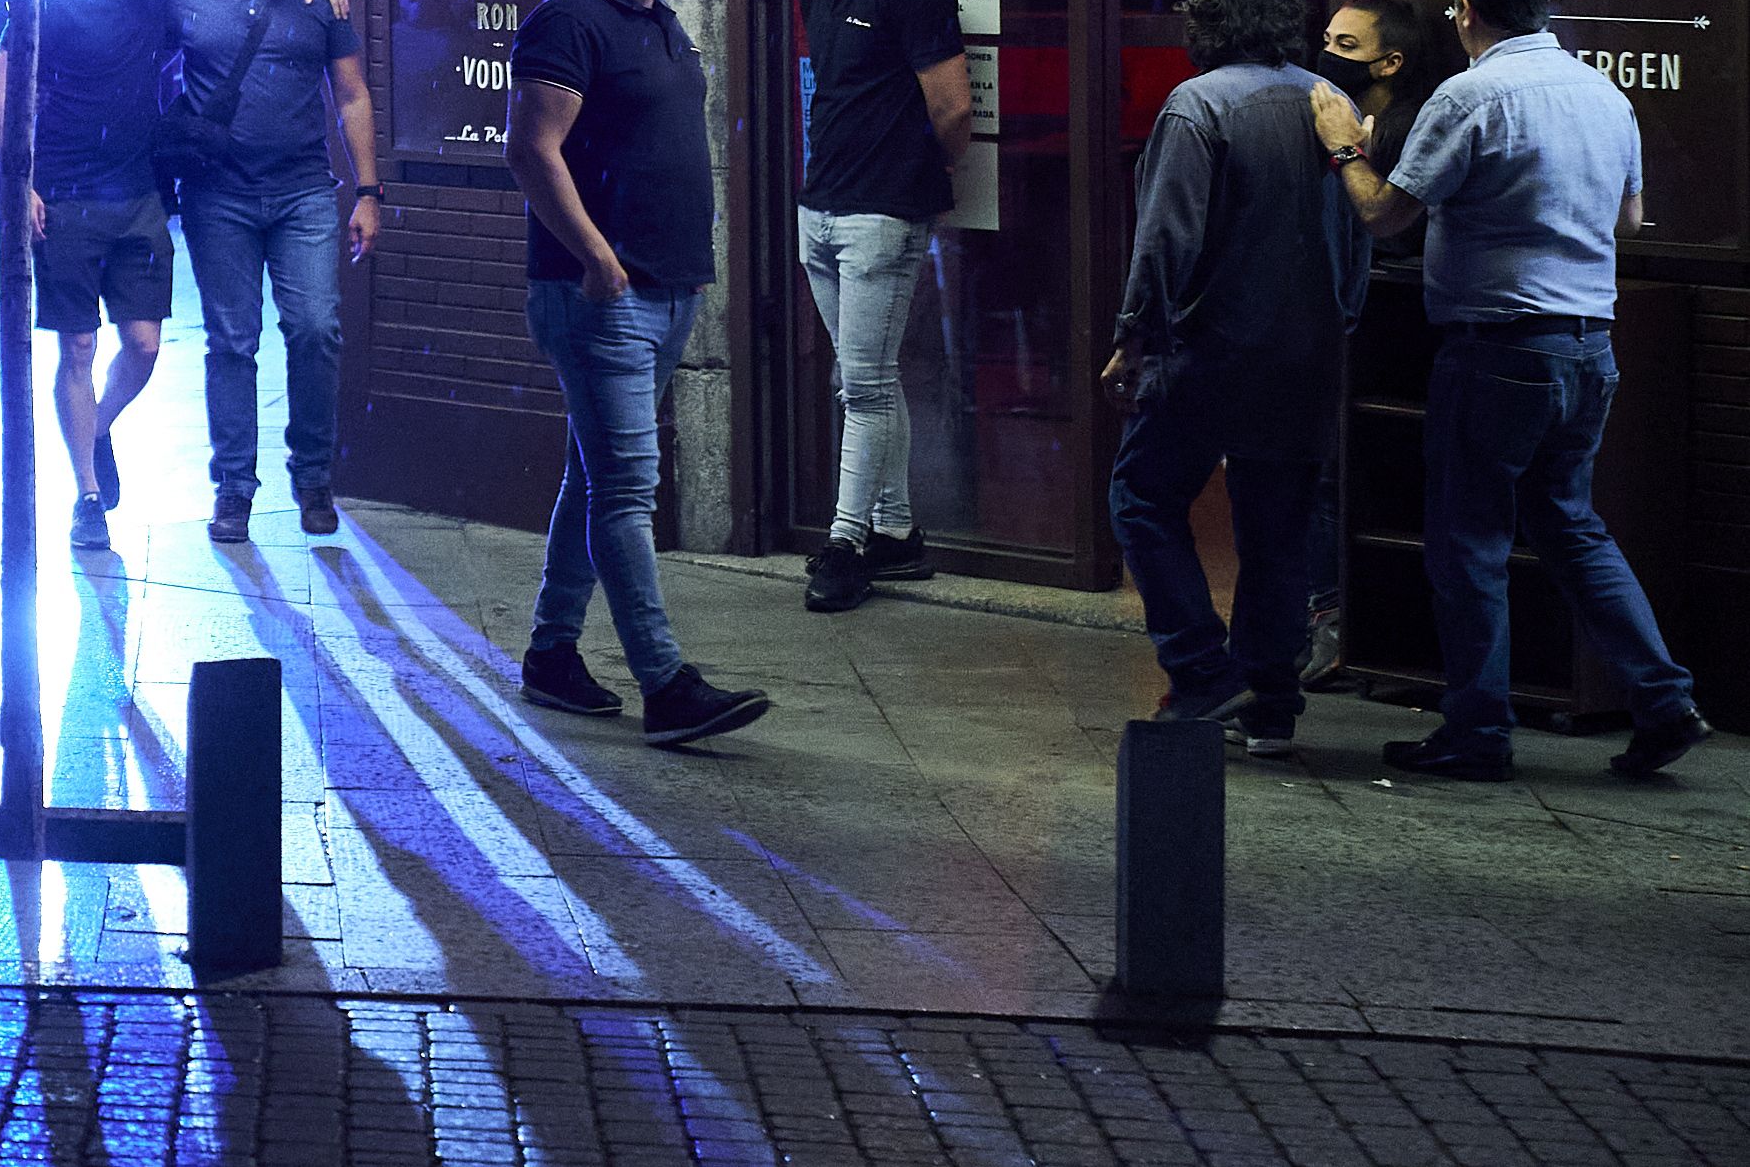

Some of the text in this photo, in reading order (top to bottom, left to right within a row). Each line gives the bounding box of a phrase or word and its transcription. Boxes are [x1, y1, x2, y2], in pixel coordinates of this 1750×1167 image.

[476, 2, 519, 30] RON
[463, 55, 512, 90] VOD
[1576, 49, 1681, 91] RGEN
[456, 124, 509, 143] La Pot
